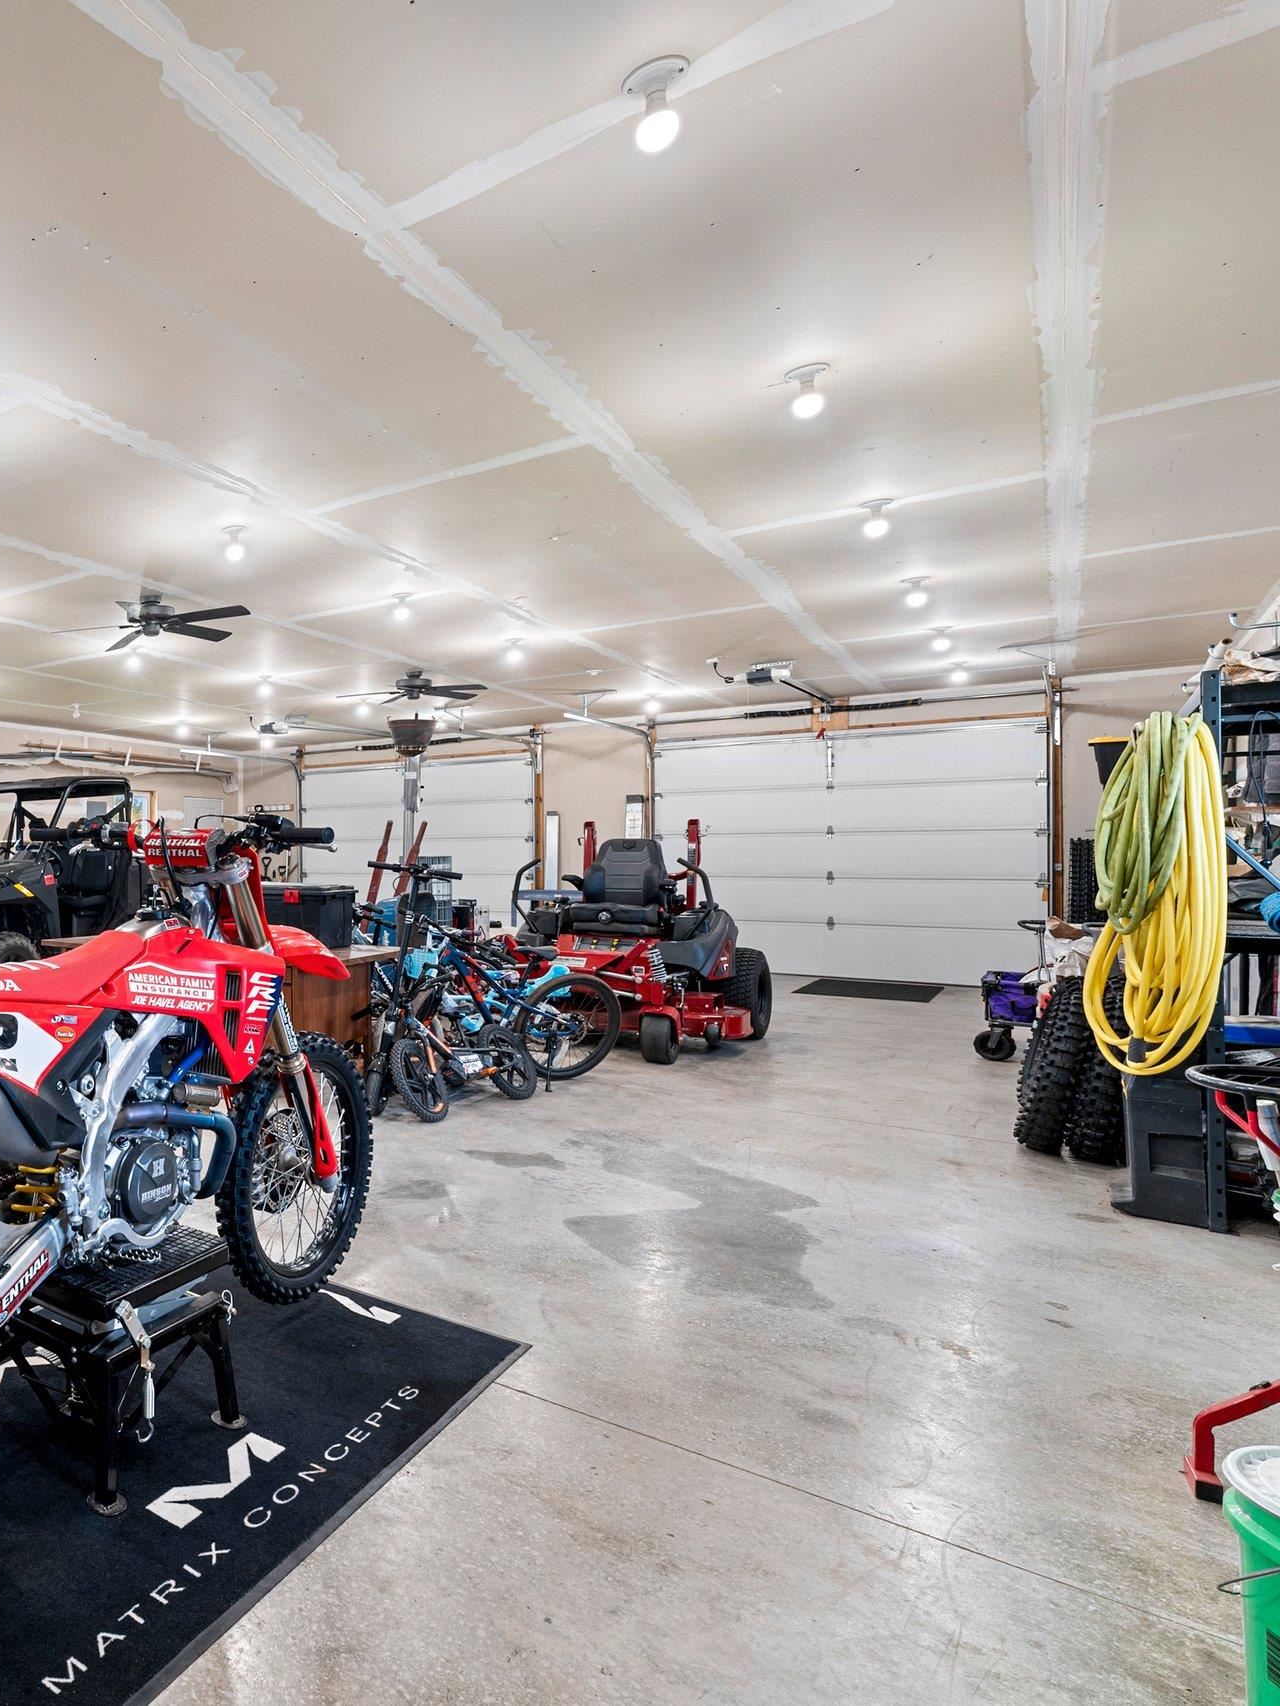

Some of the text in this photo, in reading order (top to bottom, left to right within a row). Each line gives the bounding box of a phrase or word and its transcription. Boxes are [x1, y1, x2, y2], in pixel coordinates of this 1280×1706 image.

[128, 972, 215, 989] AMERICAN FAMILY
[136, 985, 208, 997] INSURANCE
[246, 971, 278, 1015] CRF
[131, 995, 215, 1012] JOE HAVEL AGENCY
[41, 1385, 420, 1695] MATRIX CONCEPTS
